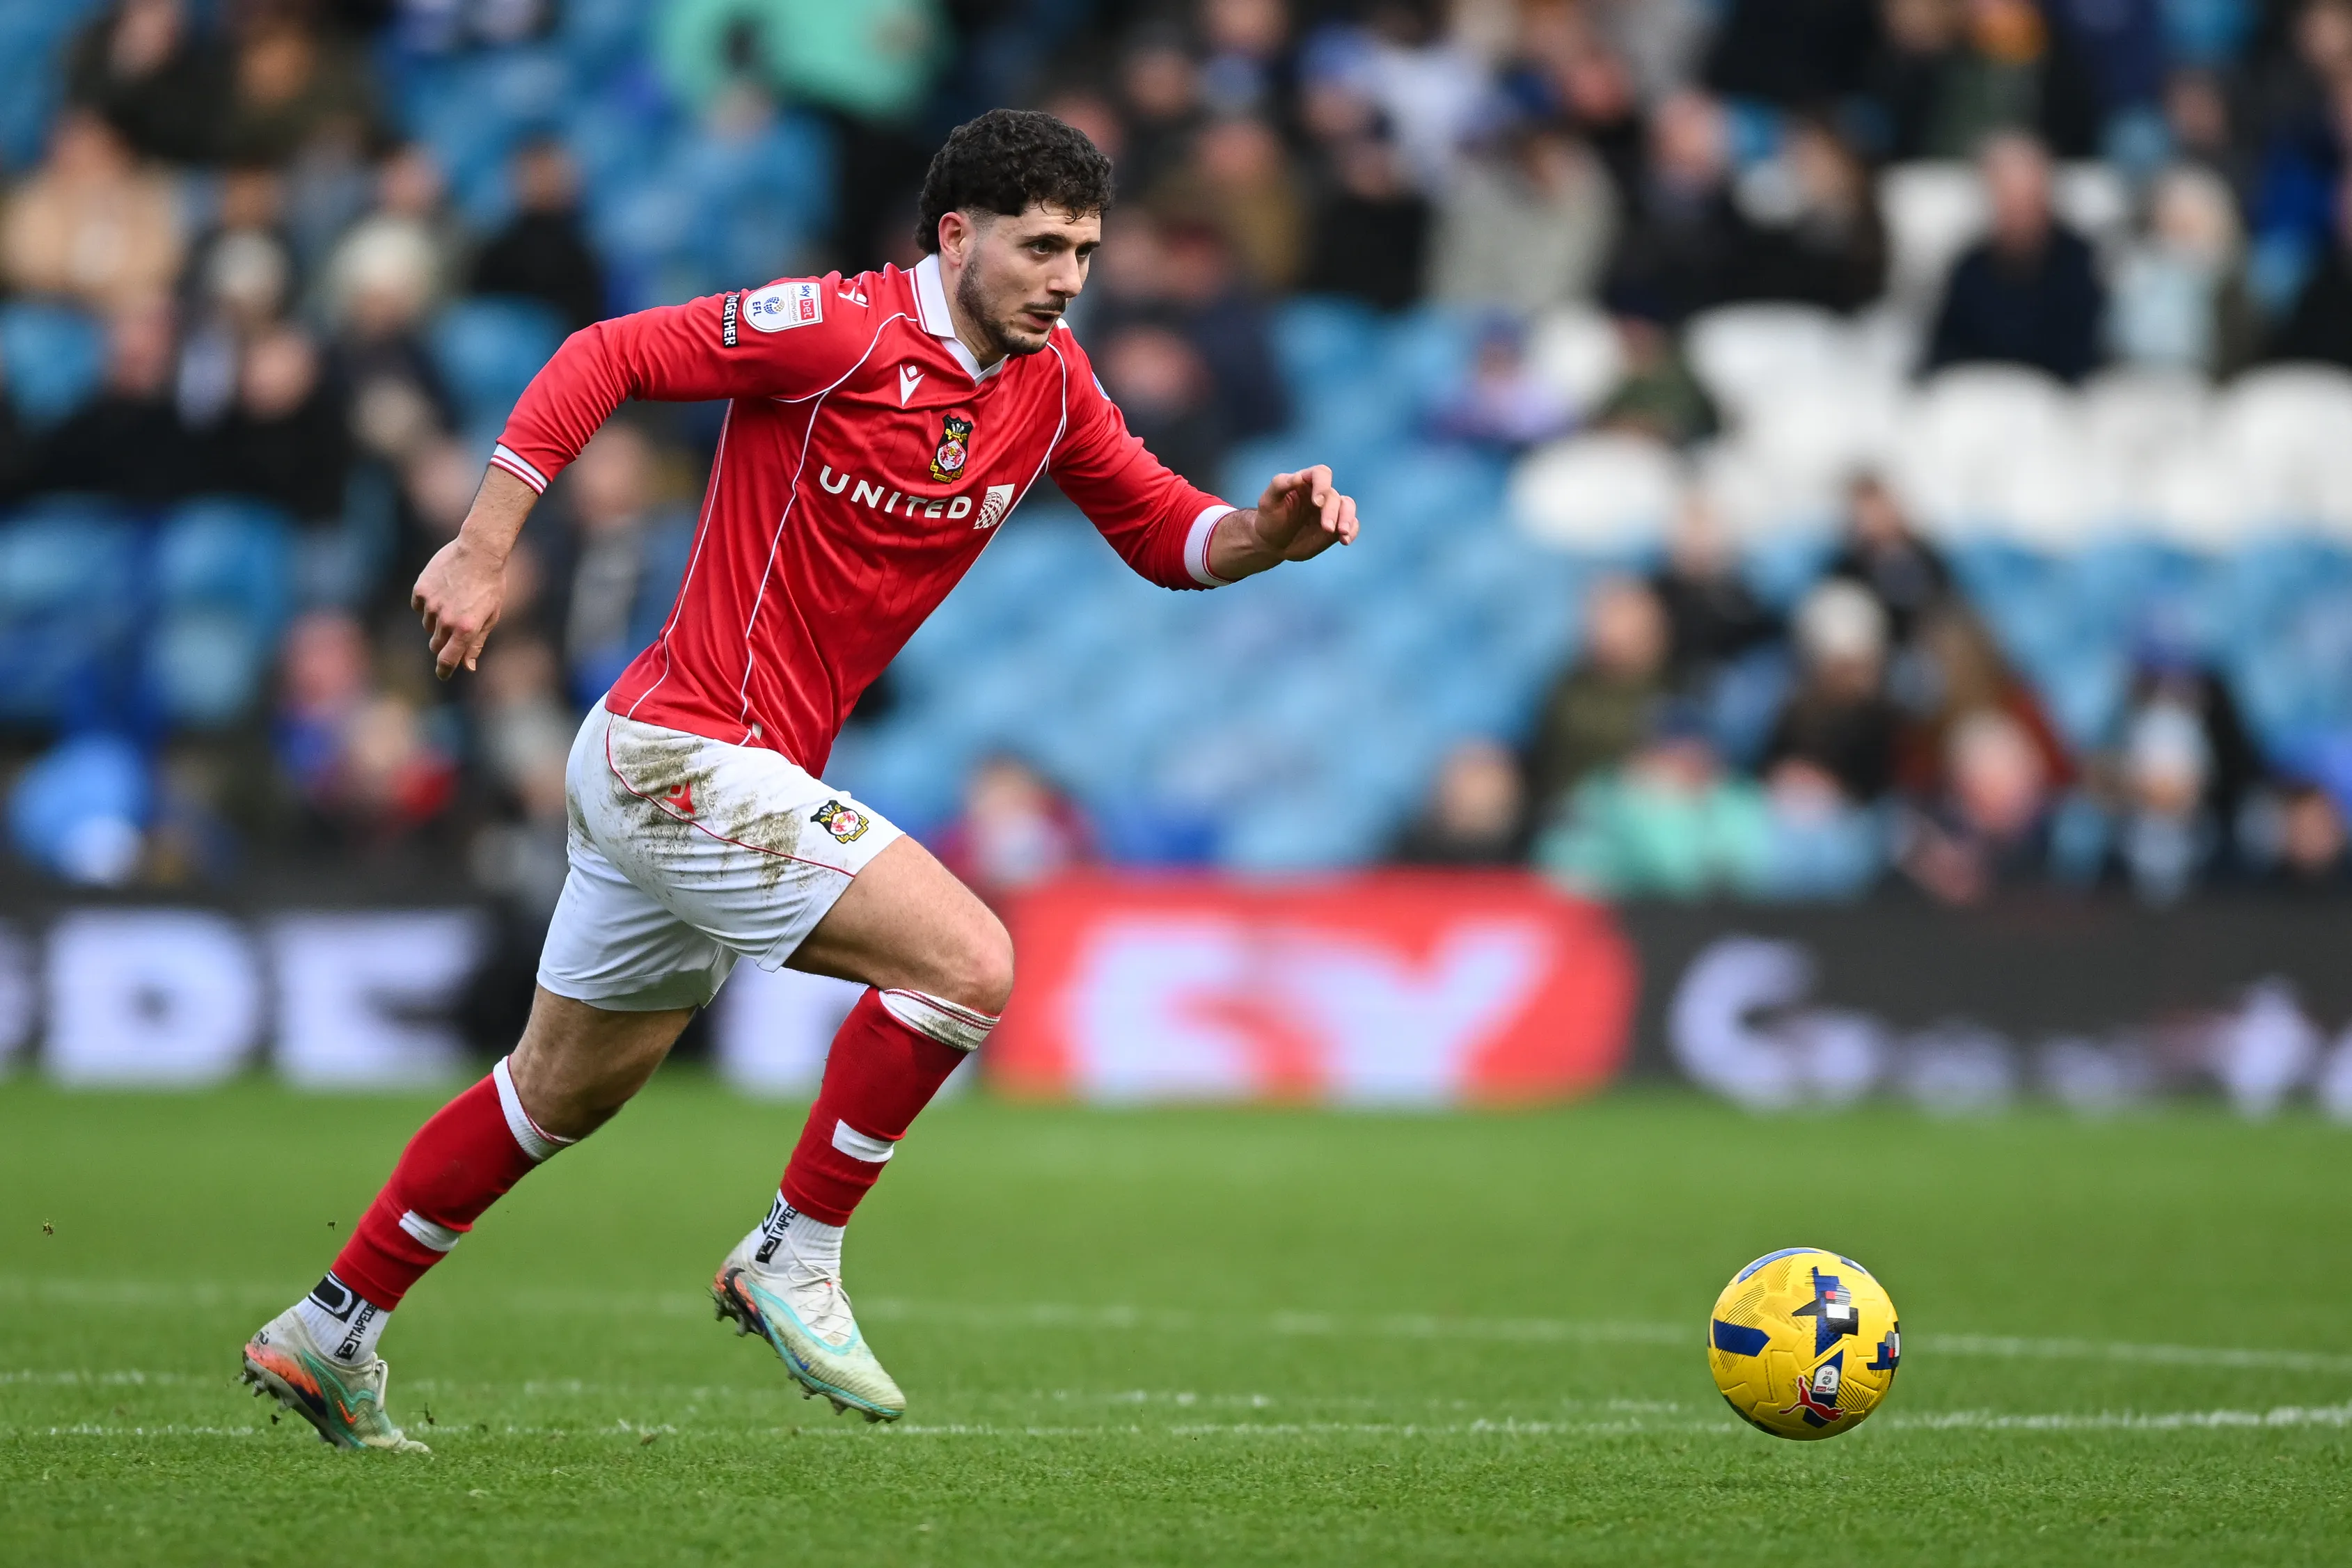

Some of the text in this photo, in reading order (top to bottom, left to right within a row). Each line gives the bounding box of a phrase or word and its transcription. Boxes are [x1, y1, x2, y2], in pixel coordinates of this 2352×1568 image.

[752, 301, 761, 317] EFL
[800, 285, 812, 318] sky bet
[819, 465, 972, 518] UNITED
